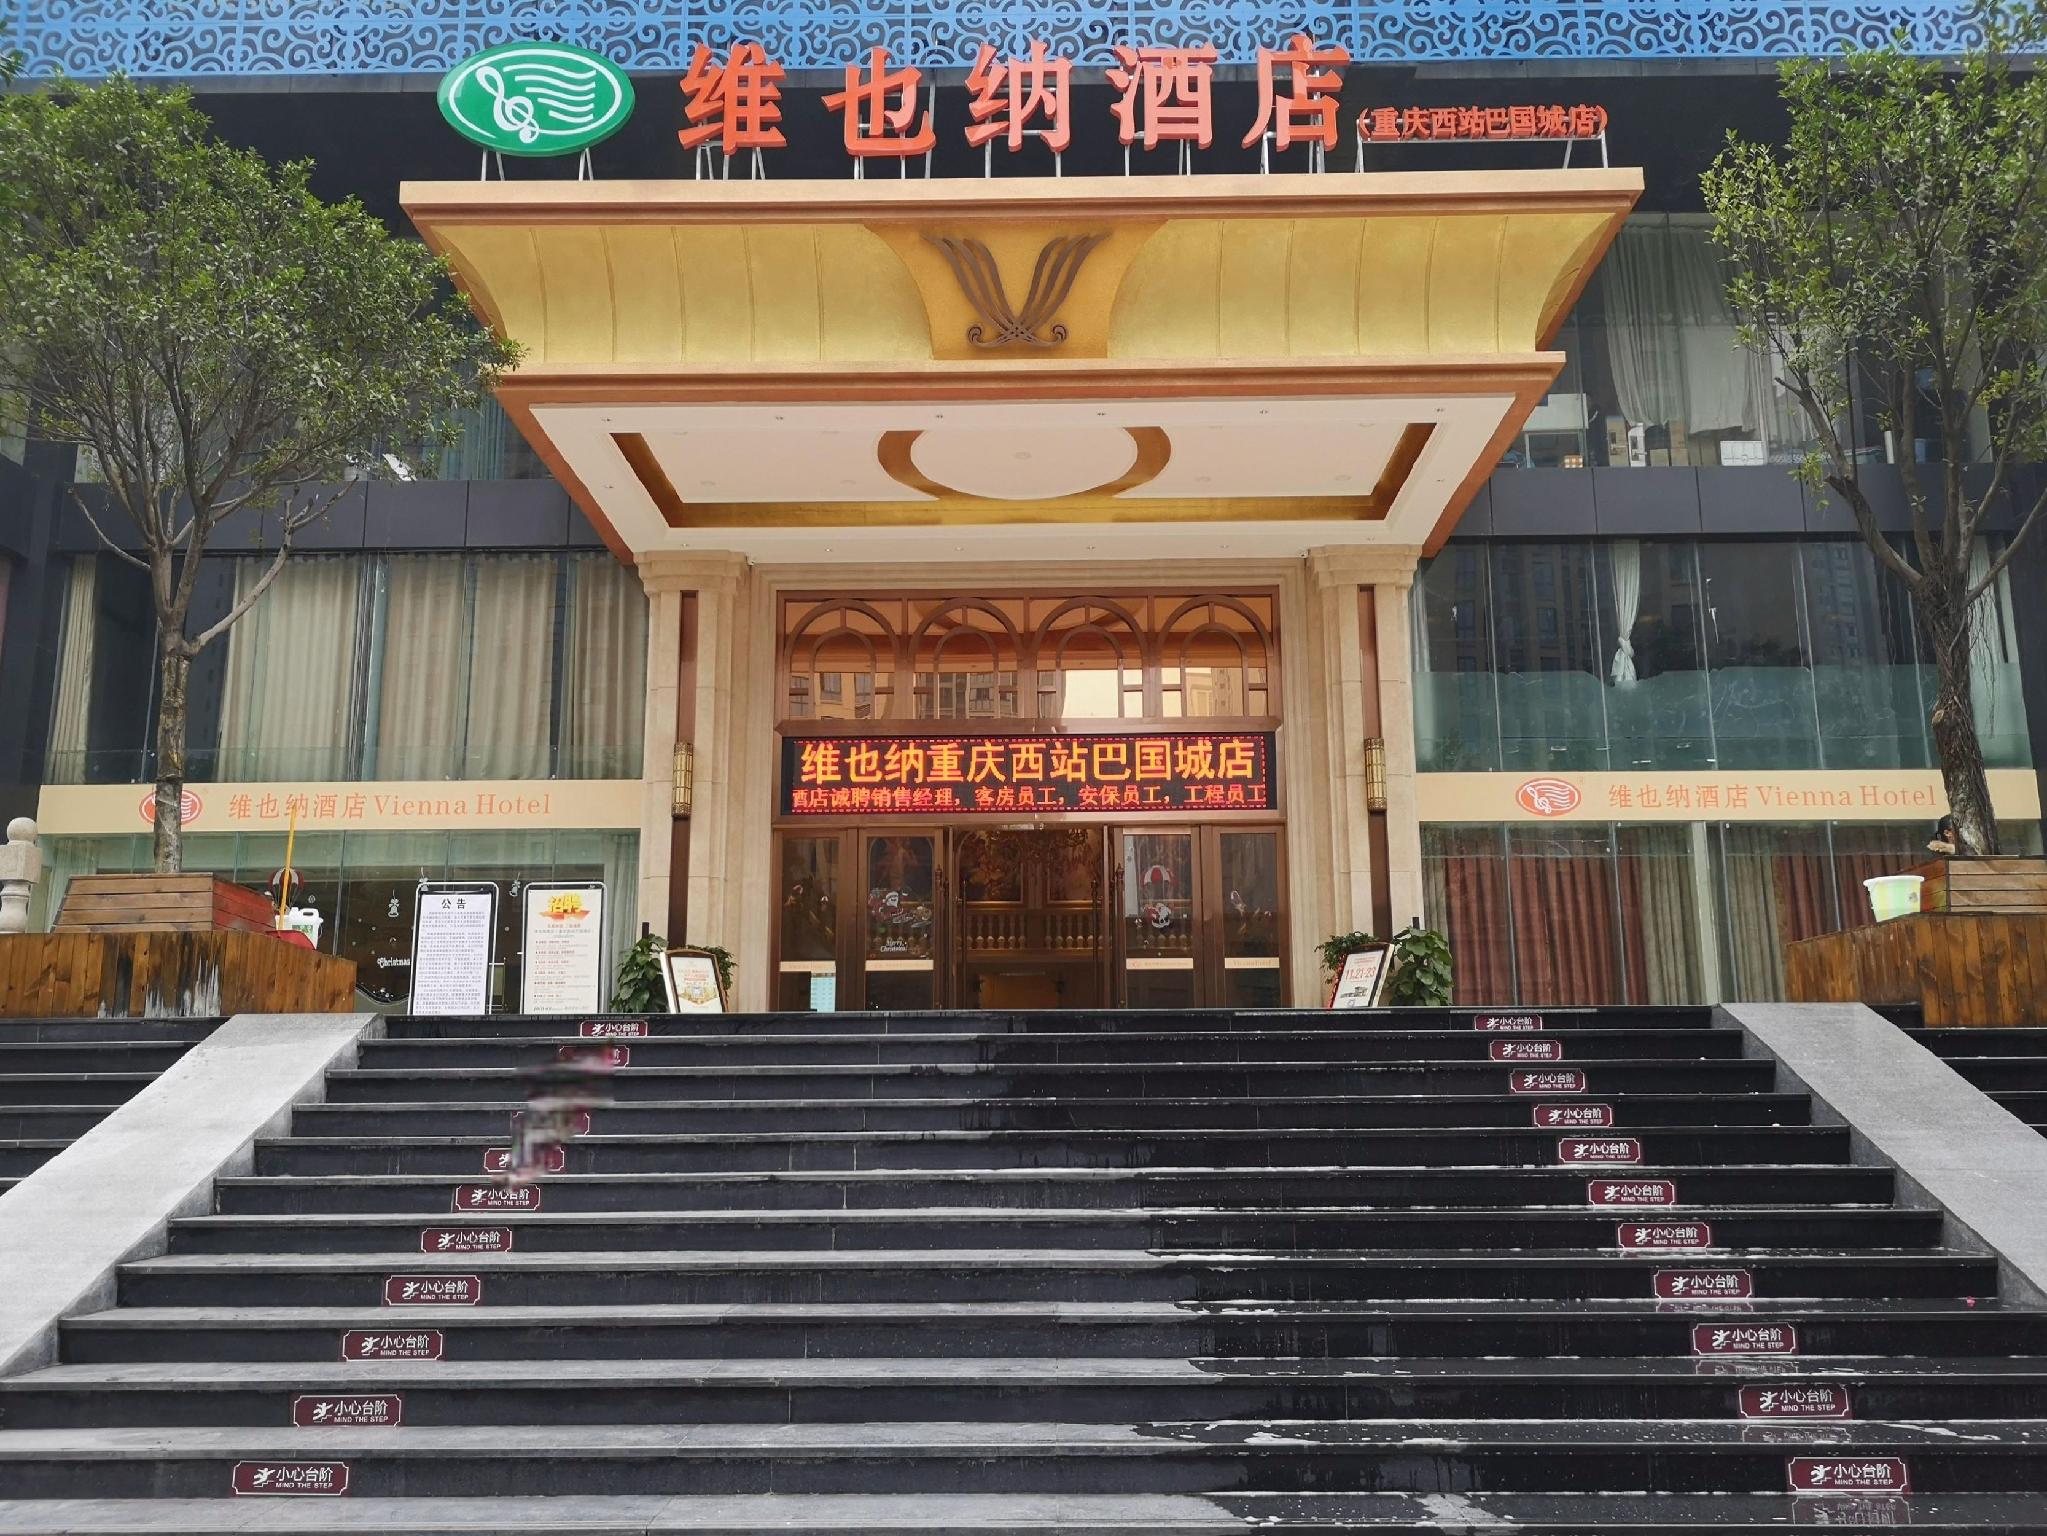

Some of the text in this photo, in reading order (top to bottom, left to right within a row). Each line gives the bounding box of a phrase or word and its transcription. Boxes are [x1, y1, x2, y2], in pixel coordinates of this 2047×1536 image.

[677, 33, 1350, 156] 维也纳酒店
[800, 739, 1255, 784] 维也纳重庆西站巴国城店
[1608, 784, 1937, 808] 维也纳酒店 Vienna Hotel
[228, 793, 551, 819] 维也纳酒店 Vienna Hotel
[442, 898, 466, 909] 公告
[605, 1022, 639, 1032] 小心台阶
[1500, 1016, 1532, 1025] 小心台阶
[1517, 1043, 1551, 1053] 小心台阶
[1538, 1073, 1575, 1084] 小心台阶
[1564, 1108, 1602, 1119] 小心台阶
[1589, 1143, 1630, 1155] 小心台阶
[1621, 1185, 1664, 1197] 小心台阶
[456, 1231, 501, 1244] 小心台阶
[1653, 1227, 1698, 1239] 小心台阶
[421, 1281, 469, 1294] 小心台阶
[1691, 1274, 1739, 1289] 小心台阶
[1732, 1328, 1782, 1342] 小心台阶
[380, 1335, 430, 1349] 小心台阶
[1780, 1390, 1833, 1404] 小心台阶
[334, 1400, 389, 1416] 小心台阶
[276, 1467, 333, 1482] 小心台阶
[1834, 1463, 1892, 1479] 小心台阶
